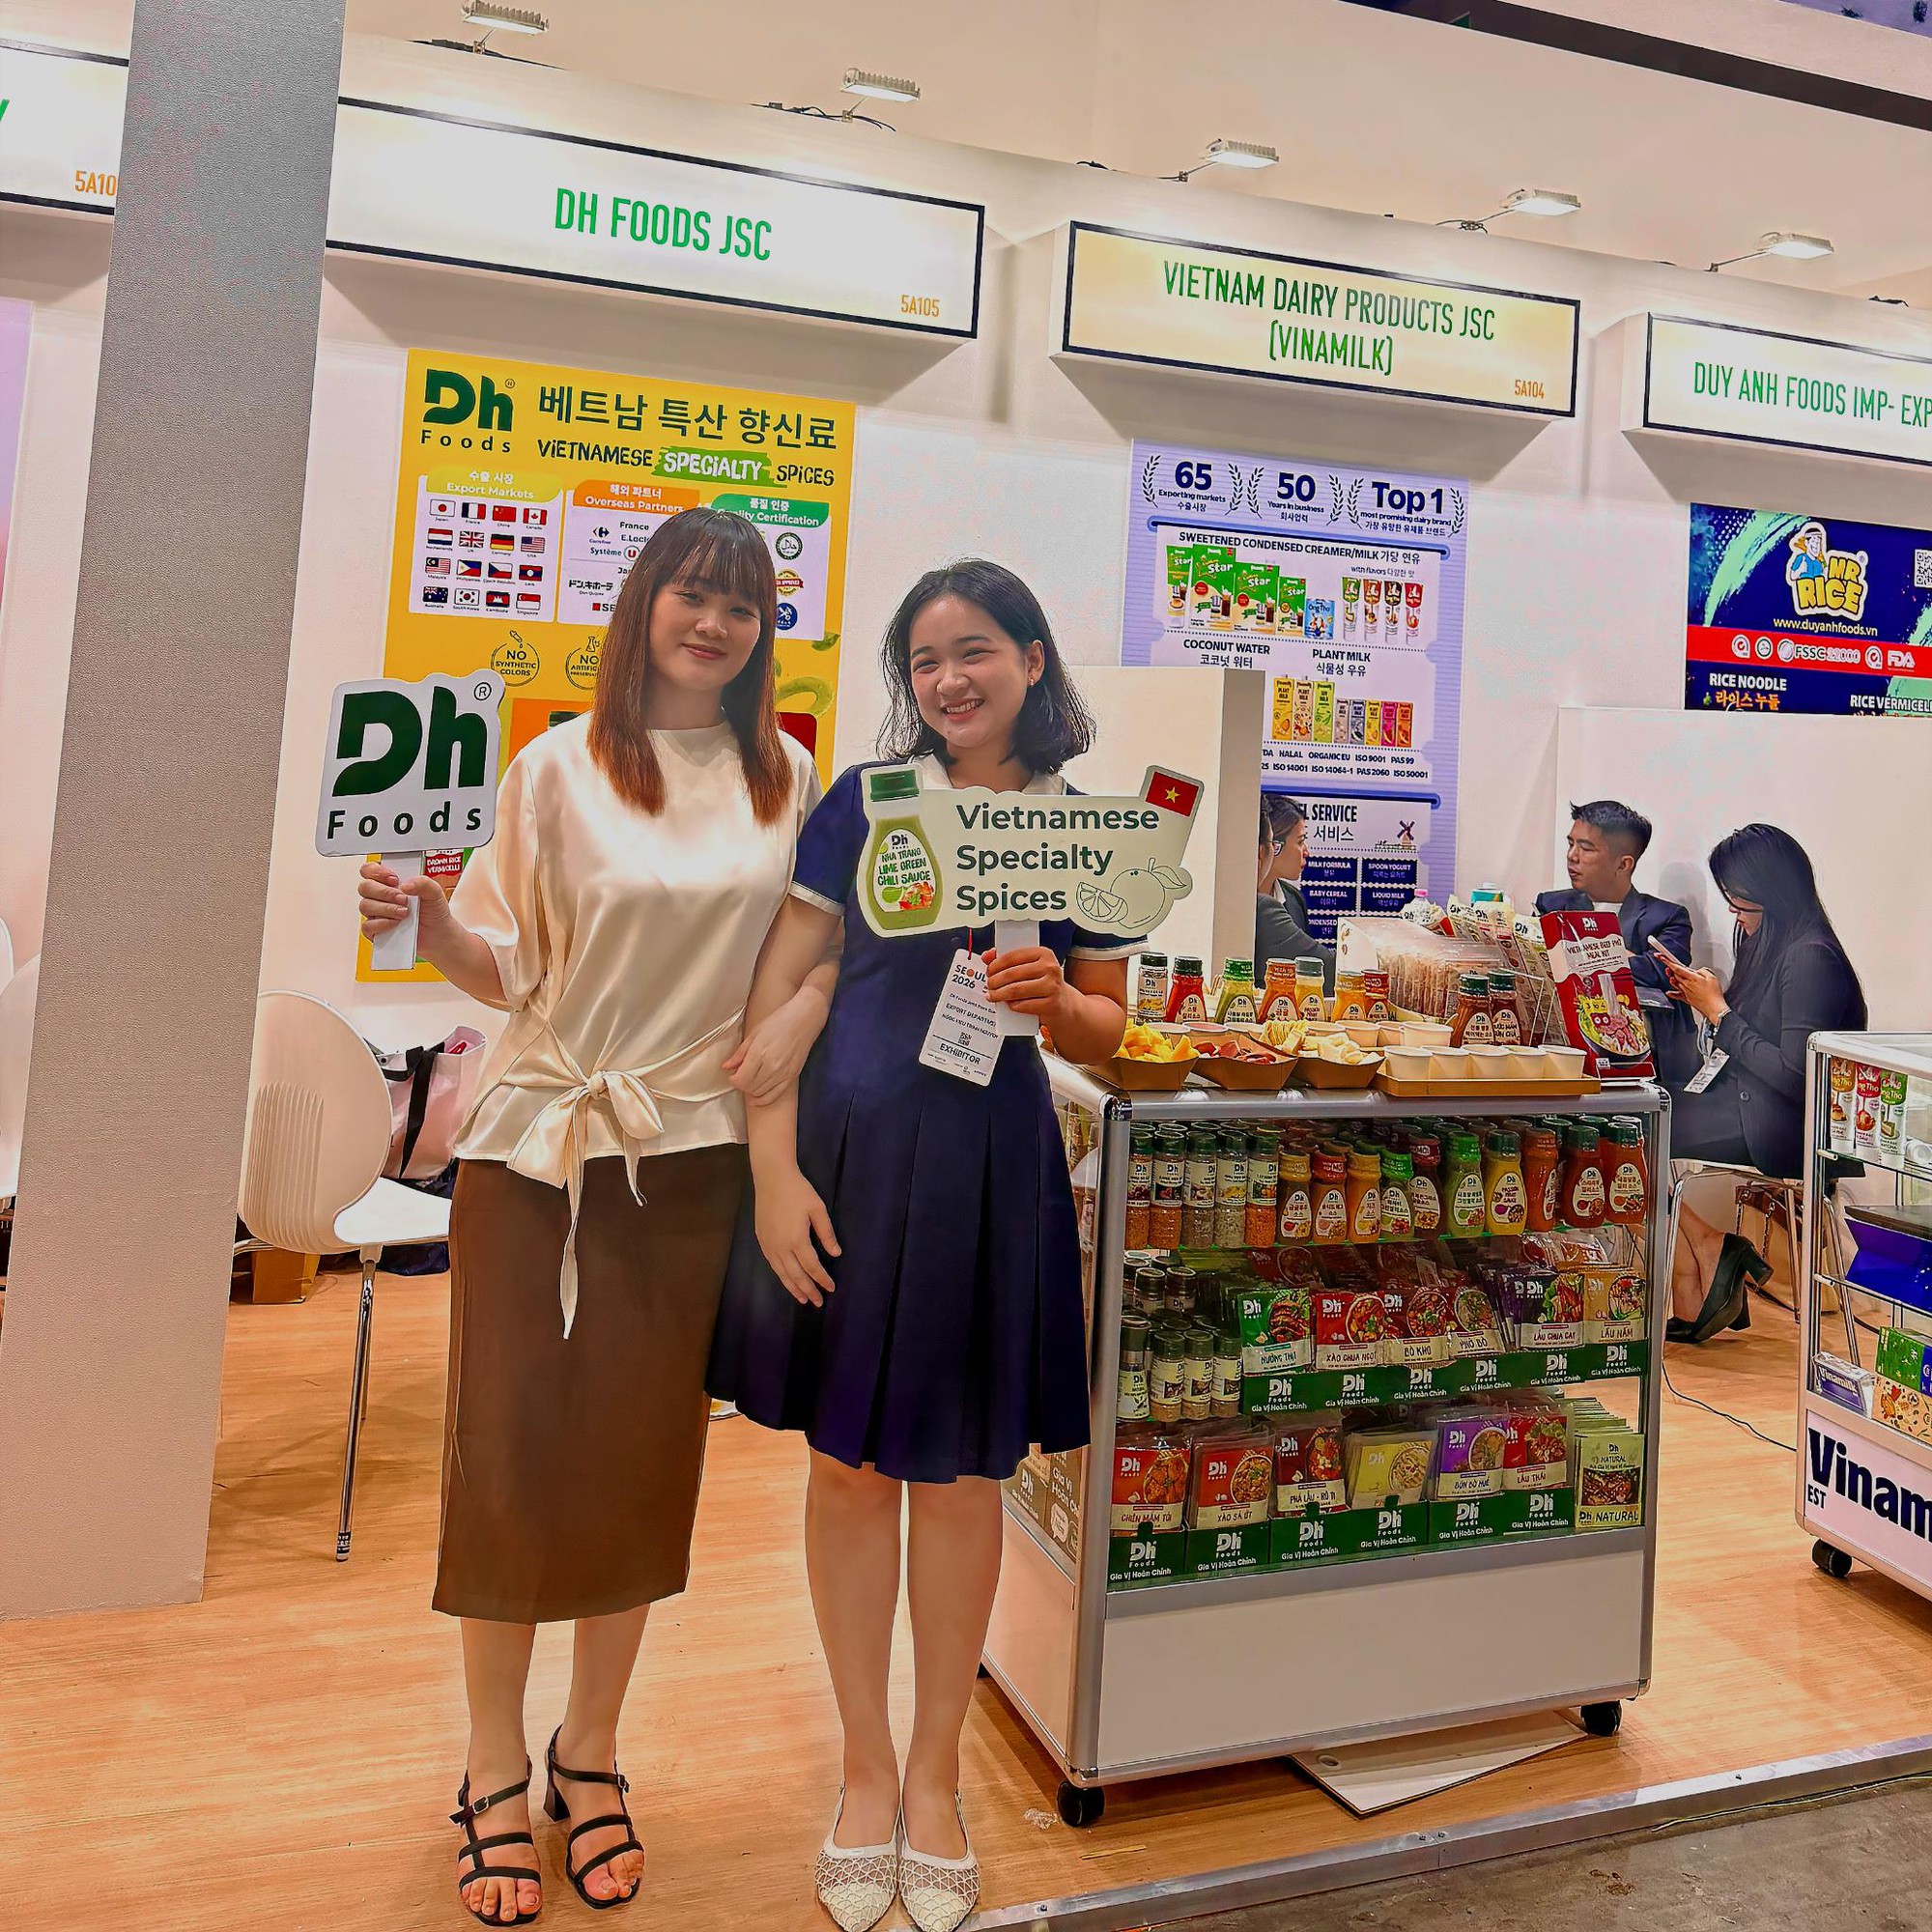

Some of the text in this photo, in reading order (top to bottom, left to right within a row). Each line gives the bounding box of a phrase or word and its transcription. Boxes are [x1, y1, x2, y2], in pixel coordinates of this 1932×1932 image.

[74, 170, 117, 196] 5A10
[554, 187, 772, 261] DH FOODS JSC
[900, 294, 940, 318] 5A105
[1164, 261, 1495, 341] VIETNAM DAIRY PRODUCTS JSC
[1514, 379, 1545, 399] 5A104
[1693, 361, 1733, 398] DUY
[1739, 369, 1777, 405] ANH
[1786, 376, 1845, 415] FOODS
[1853, 386, 1894, 421] IMP-
[423, 368, 513, 432] Dh
[538, 386, 837, 449] 베트남 특산 향신료
[421, 429, 511, 453] Foods
[1175, 461, 1213, 491] 65
[446, 482, 534, 499] Export Markets
[1276, 471, 1316, 502] 50
[1158, 489, 1226, 502] Exporting markets
[1372, 481, 1444, 515] Top 1
[584, 496, 685, 513] Overseas Partners
[1267, 500, 1287, 511] Years
[1294, 503, 1324, 514] business
[619, 522, 649, 530] France
[756, 511, 819, 526] Certification
[1378, 512, 1412, 524] promising
[1432, 517, 1452, 526] brand
[1179, 531, 1241, 547] SWEETENED
[1242, 538, 1303, 553] CONDENSED
[1304, 544, 1379, 560] CREAMER/MILK
[1208, 563, 1234, 574] Star
[1828, 555, 1861, 582] MR
[1248, 578, 1271, 587] Star
[1796, 576, 1863, 614] RICE
[1773, 618, 1878, 637] www.duyanhfoods.vn
[506, 650, 526, 661] NO
[1183, 639, 1270, 655] COCONUT WATER
[1312, 648, 1371, 663] PLANT MILK
[1795, 644, 1827, 661] FSSC
[496, 661, 536, 669] SYNTHETIC
[580, 655, 599, 665] NO
[1200, 654, 1253, 668] 코코넛 워터
[1887, 650, 1916, 668] FDA
[500, 668, 530, 676] COLORS
[1709, 672, 1787, 692] RICE NOODLE
[1850, 695, 1875, 708] RICE
[331, 686, 488, 798] Dh
[1308, 751, 1341, 760] ORGANIC
[1368, 754, 1386, 763] 9001
[1287, 764, 1308, 773] 14001
[1356, 767, 1371, 776] PAS
[1393, 769, 1405, 778] ISO
[327, 801, 481, 839] Foods
[955, 802, 1160, 830] Vietnamese
[1311, 803, 1358, 822] SERVICE
[891, 834, 908, 845] Dh
[1313, 825, 1354, 842] 서비스
[878, 857, 927, 875] LIME GREEN
[956, 842, 1114, 875] Specialty
[900, 870, 931, 884] SAUCE
[956, 883, 1067, 917] Spices
[952, 974, 976, 989] 2026
[940, 1042, 981, 1065] EXHIBITOR
[1449, 1430, 1466, 1444] Dh
[1121, 1457, 1141, 1472] Dh
[1601, 1455, 1627, 1463] NATURAL
[1208, 1460, 1228, 1476] Dh
[1807, 1483, 1827, 1509] EST
[1578, 1511, 1638, 1522] Dh NATURAL
[1215, 1531, 1243, 1552] Dh
[1129, 1540, 1157, 1561] Dh
